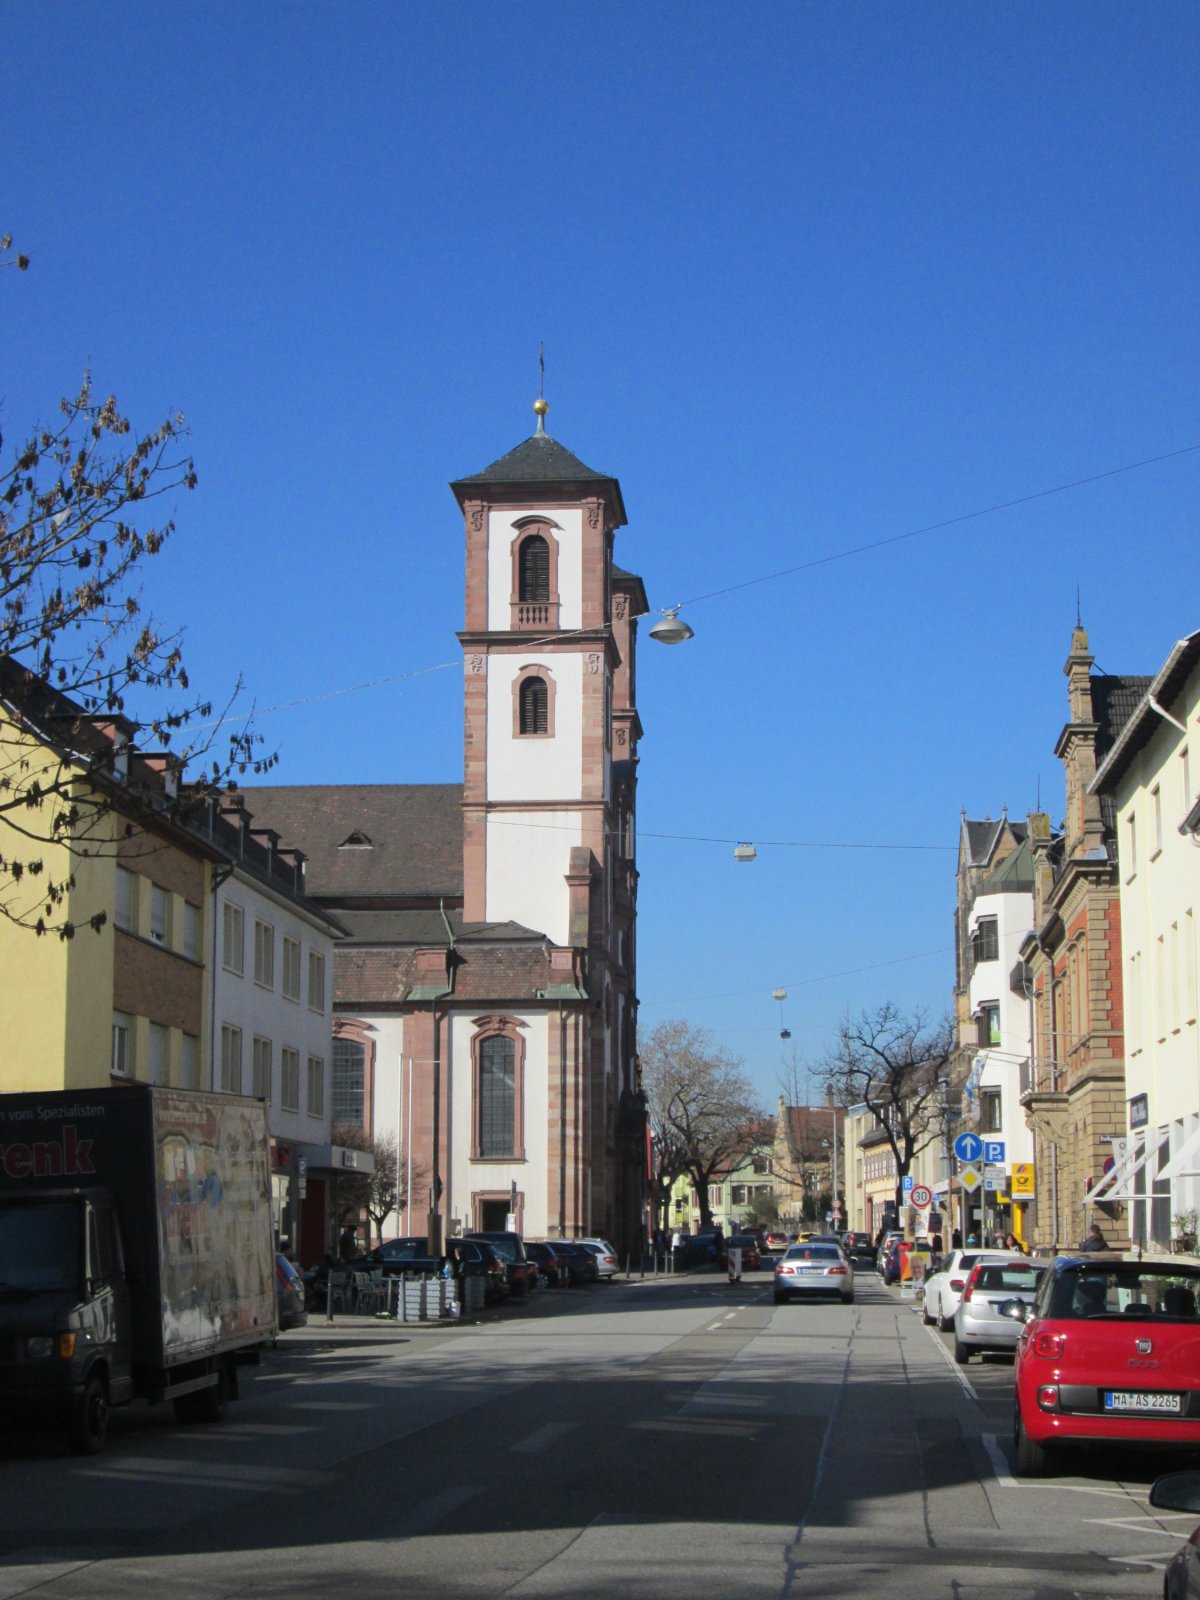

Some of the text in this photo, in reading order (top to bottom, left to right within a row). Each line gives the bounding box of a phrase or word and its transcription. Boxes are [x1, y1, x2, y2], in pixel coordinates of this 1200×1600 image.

[8, 1110, 33, 1121] vom
[36, 1103, 105, 1122] Spezialisten
[989, 1144, 1001, 1160] P
[914, 1191, 928, 1202] 30
[1113, 1394, 1127, 1406] MA
[1136, 1394, 1149, 1407] AS
[1152, 1395, 1178, 1408] 2265
